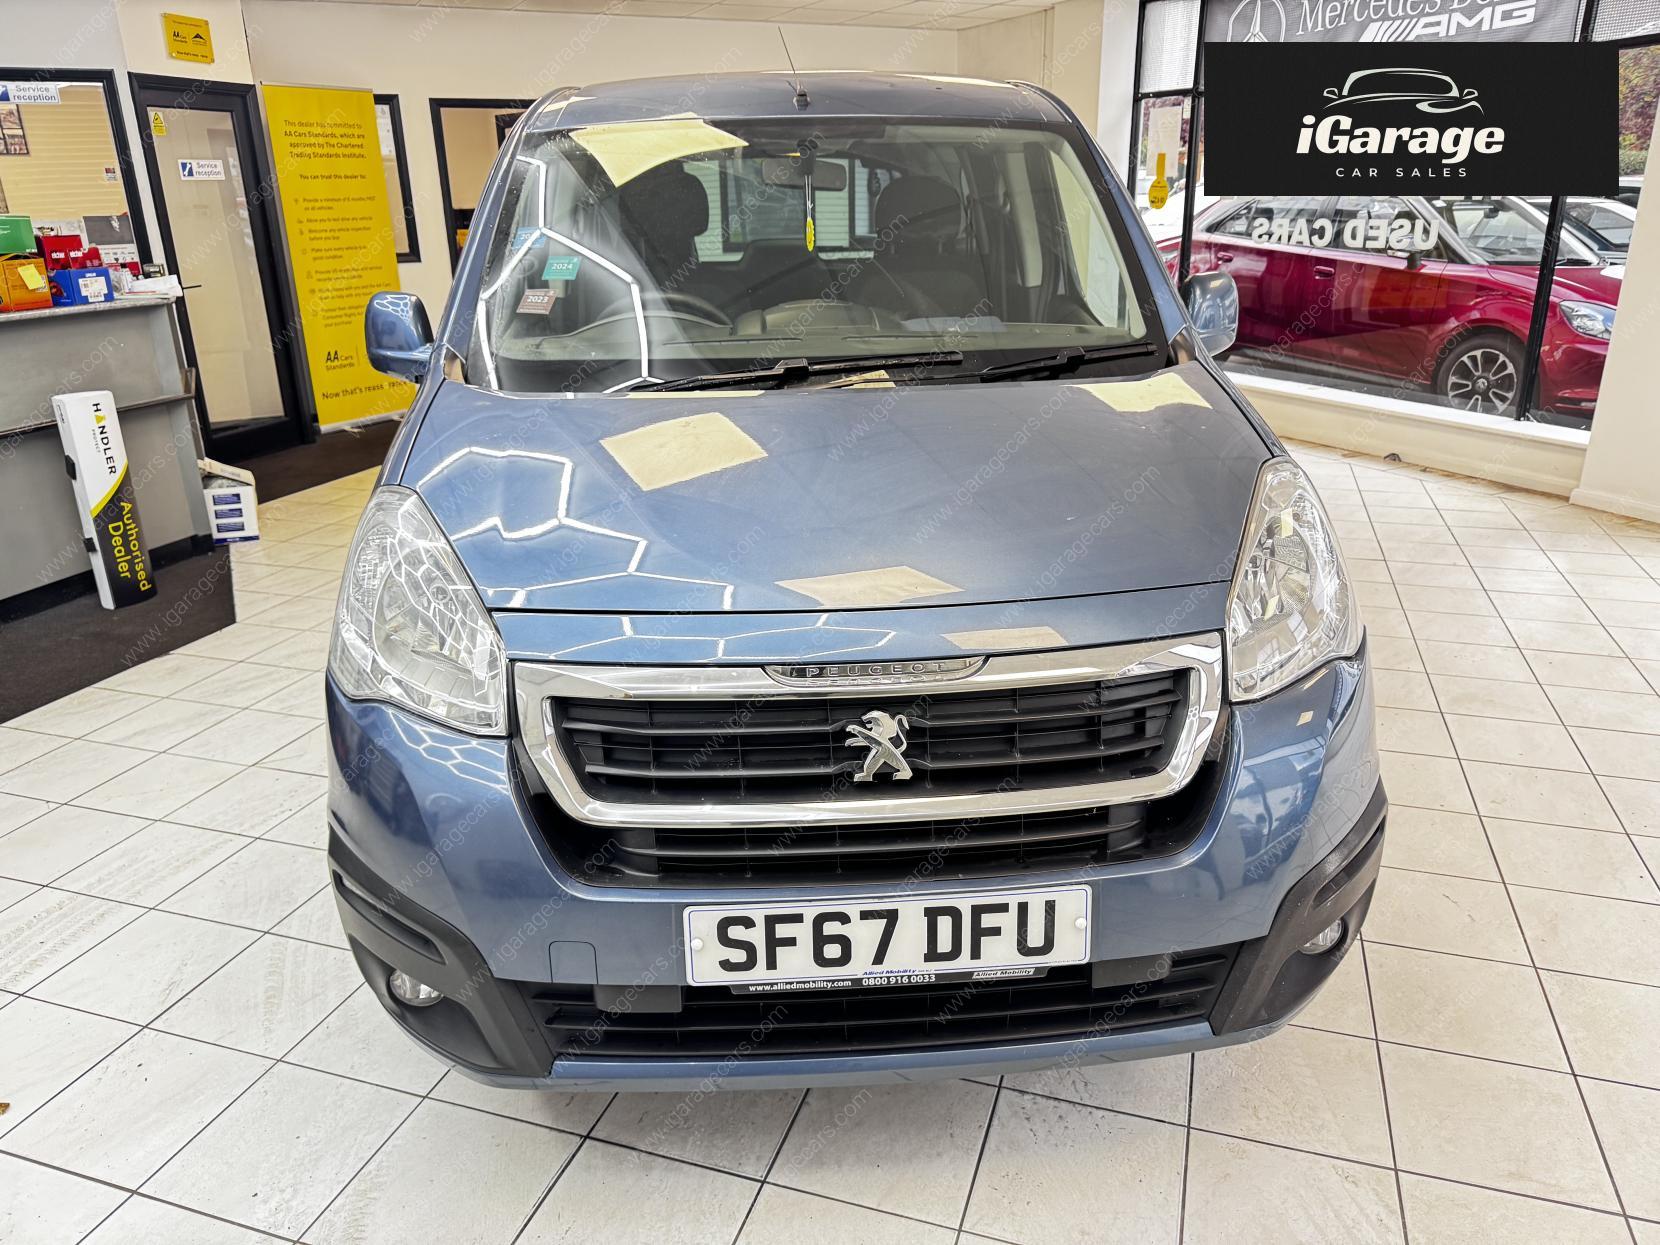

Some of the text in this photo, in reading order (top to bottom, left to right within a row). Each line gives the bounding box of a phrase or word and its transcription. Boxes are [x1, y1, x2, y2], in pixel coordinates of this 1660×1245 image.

[1407, 0, 1536, 41] AMG
[16, 85, 50, 93] Service
[13, 94, 56, 102] reception
[298, 120, 315, 128] dealer
[317, 142, 324, 150] by
[336, 142, 364, 150] Chartered
[290, 152, 312, 160] Trading
[526, 295, 549, 303] 2023
[326, 350, 339, 363] AA
[322, 391, 340, 400] Now
[341, 387, 362, 396] that's
[108, 521, 132, 578] Dealer
[120, 501, 152, 591] Authorised
[805, 663, 945, 678] PEUGEOT
[716, 899, 1057, 973] SF67 DFU
[884, 968, 917, 976] Mobility
[748, 980, 852, 992] www.alliedmobility.com
[862, 974, 936, 986] 0800 916 0033
